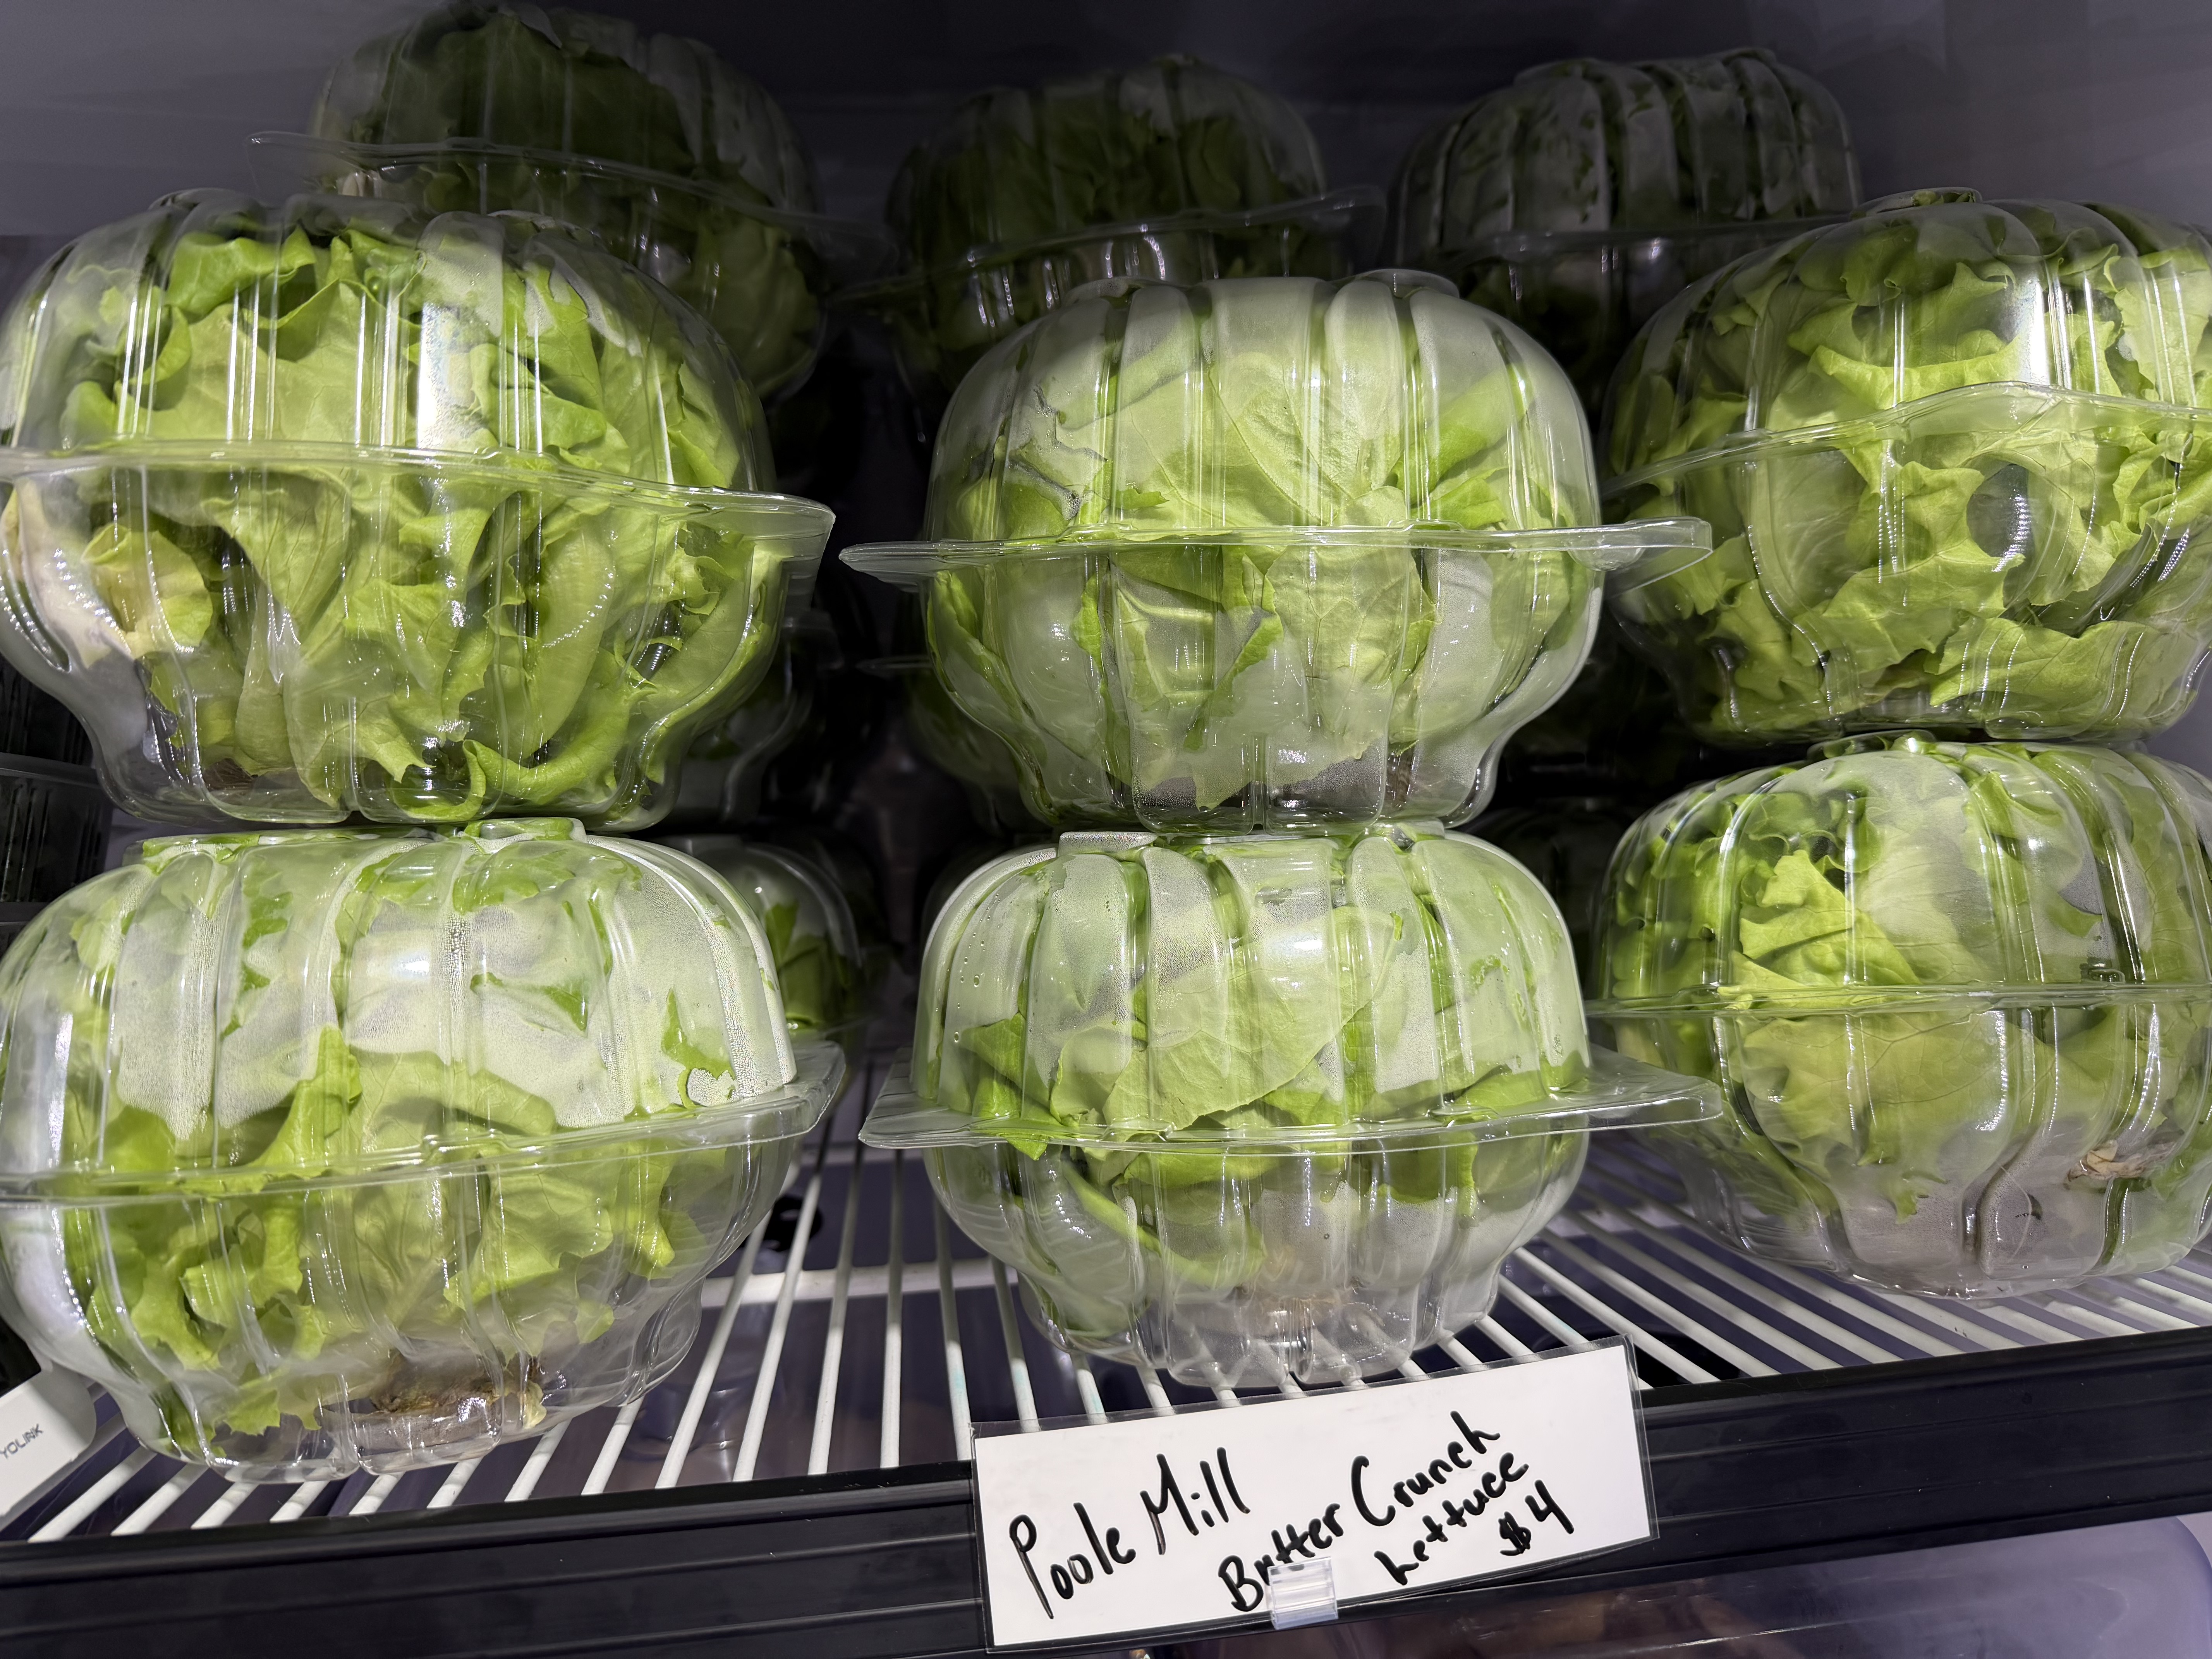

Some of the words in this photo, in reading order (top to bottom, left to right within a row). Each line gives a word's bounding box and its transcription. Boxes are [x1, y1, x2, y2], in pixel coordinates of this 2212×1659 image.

[0, 1424, 43, 1459] YOLINK
[1351, 1411, 1501, 1527] Crunch
[1009, 1503, 1136, 1620] Poole
[1140, 1447, 1251, 1555] Mill
[1374, 1452, 1529, 1586] Lettuce
[1499, 1480, 1574, 1557] $4
